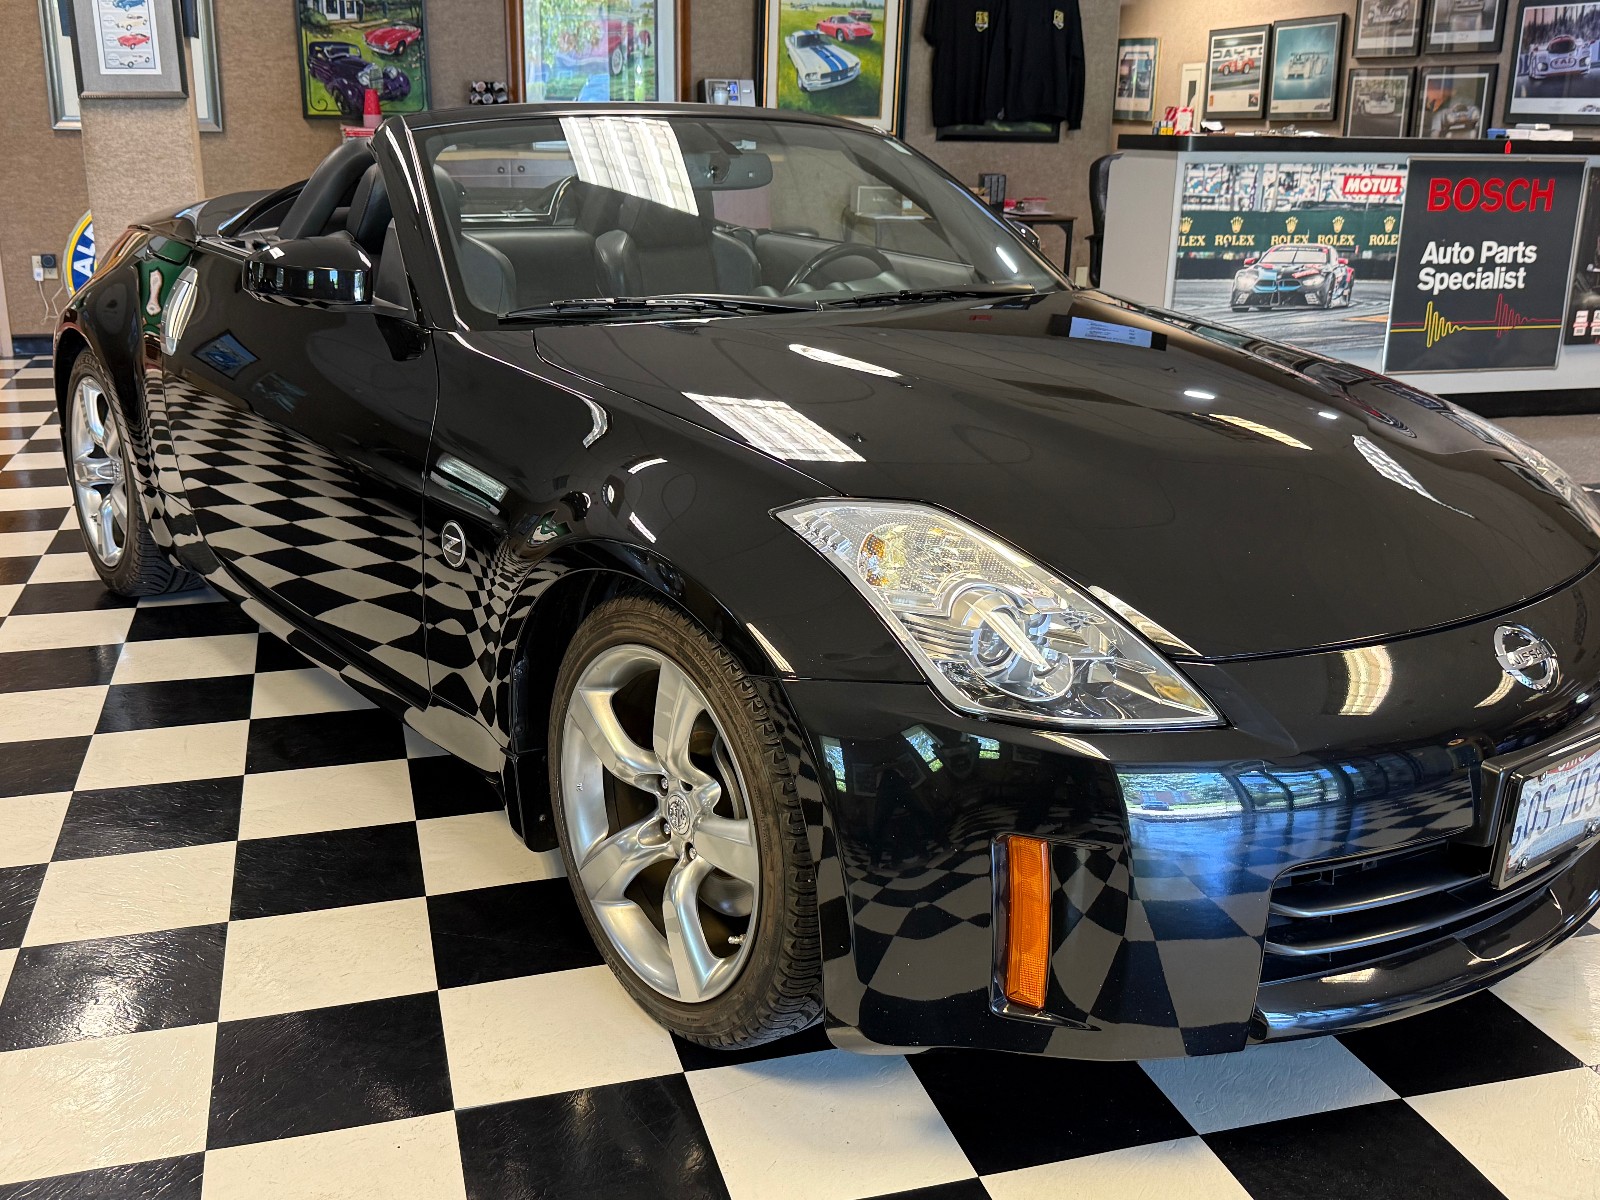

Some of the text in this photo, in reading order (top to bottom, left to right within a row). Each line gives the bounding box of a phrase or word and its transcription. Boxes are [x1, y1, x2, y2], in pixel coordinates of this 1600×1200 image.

[1344, 177, 1399, 193] MOTUL
[1427, 177, 1556, 212] BOSCH
[1178, 234, 1399, 247] LEX ROLEX ROLEX ROLEX ROLE
[1420, 241, 1537, 265] Auto Parts
[1417, 266, 1527, 295] Specialist
